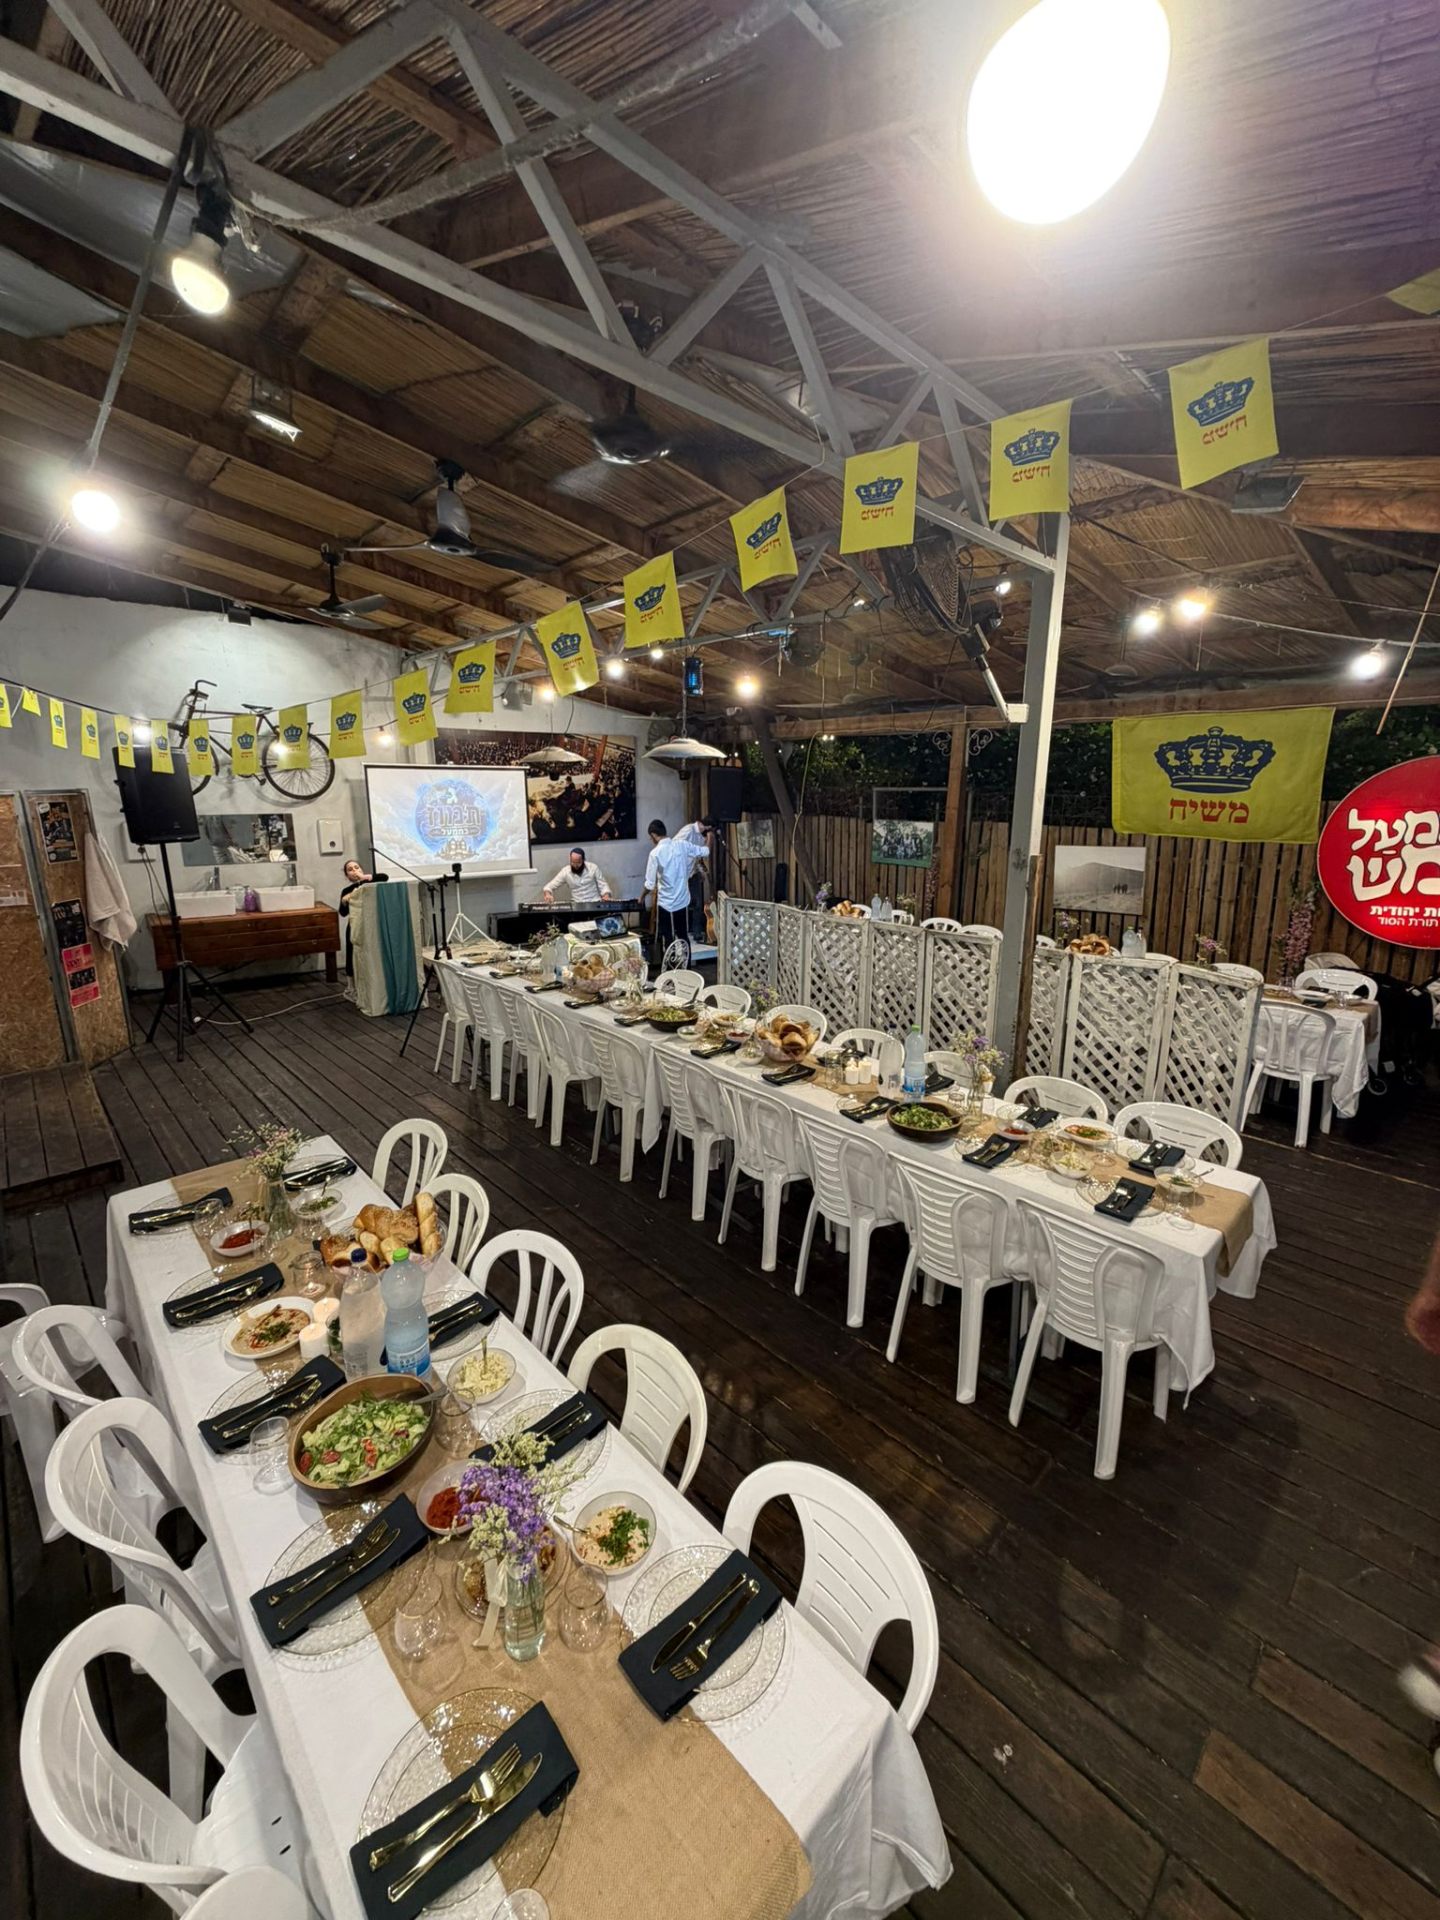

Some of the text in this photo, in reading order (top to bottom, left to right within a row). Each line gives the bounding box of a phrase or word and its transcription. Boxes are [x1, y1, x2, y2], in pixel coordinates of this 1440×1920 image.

[1169, 797, 1250, 824] משיח
[1370, 905, 1420, 916] יהודית
[1377, 916, 1439, 927] תורת הסוד
